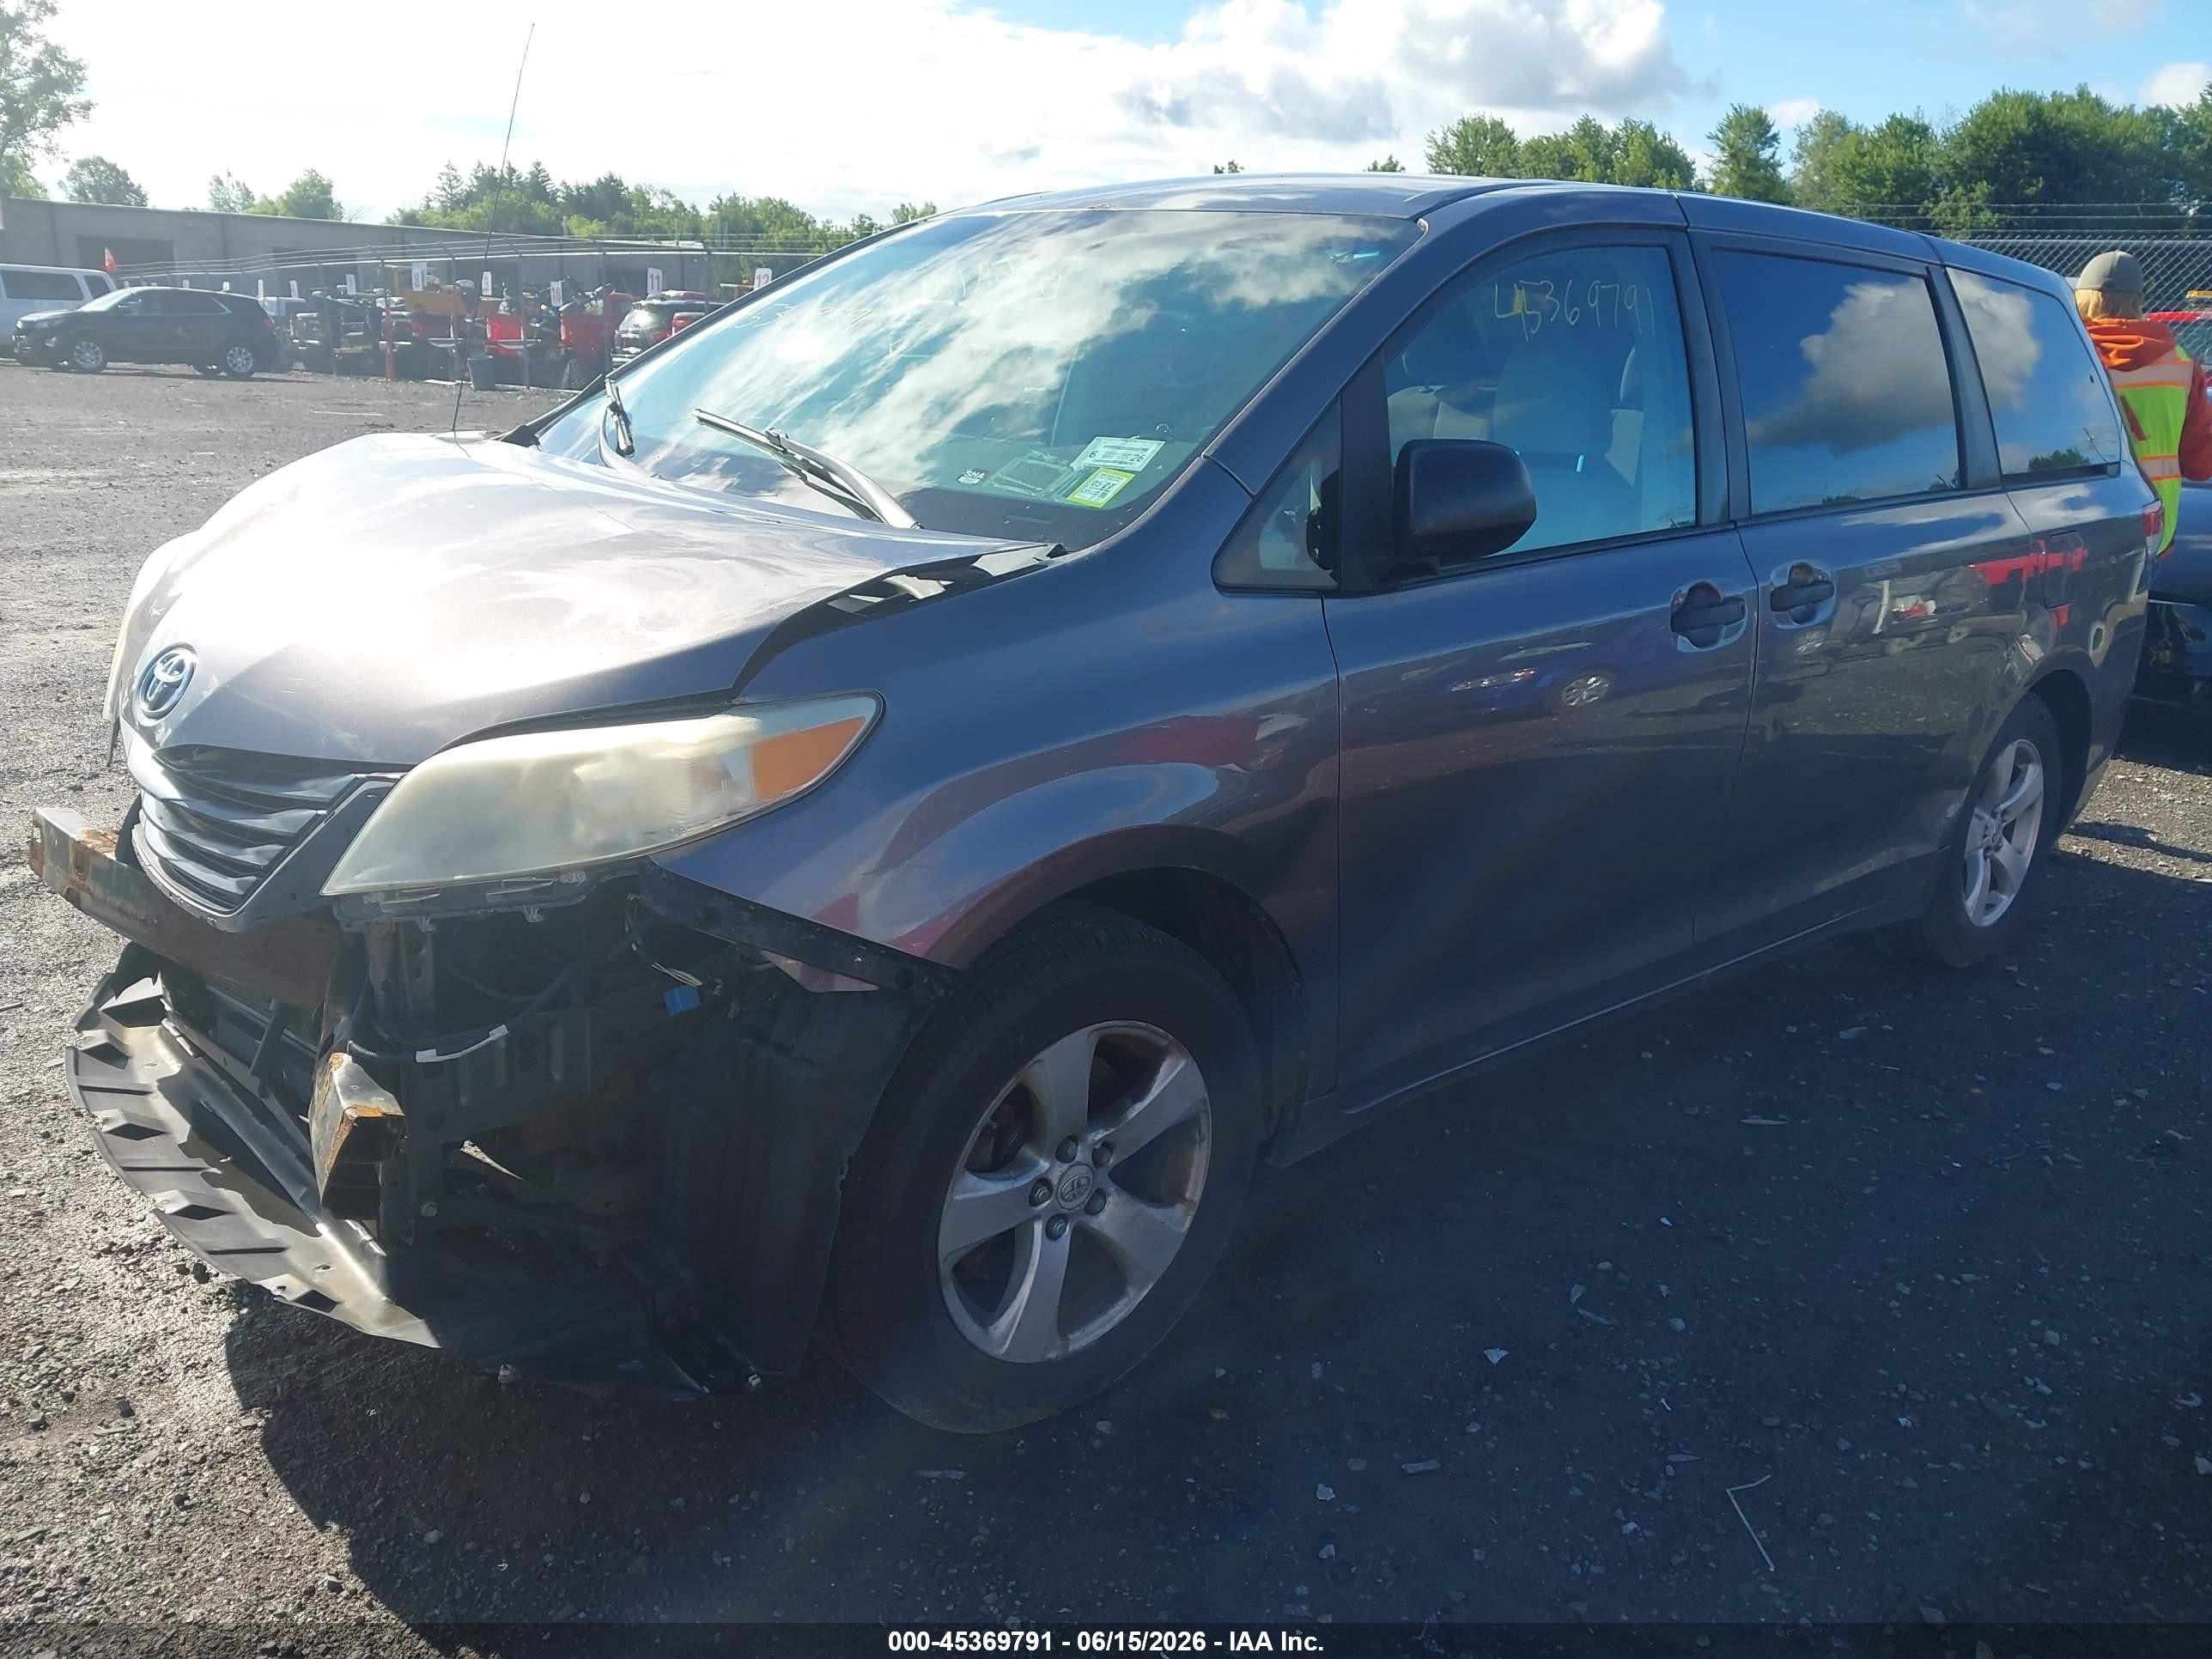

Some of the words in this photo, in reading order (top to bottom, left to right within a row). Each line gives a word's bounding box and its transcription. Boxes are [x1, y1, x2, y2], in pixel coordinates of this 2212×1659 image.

[649, 274, 661, 290] 11
[756, 274, 770, 288] 12
[1494, 280, 1656, 342] 45369791
[1089, 450, 1098, 459] 6
[1129, 453, 1146, 462] 26
